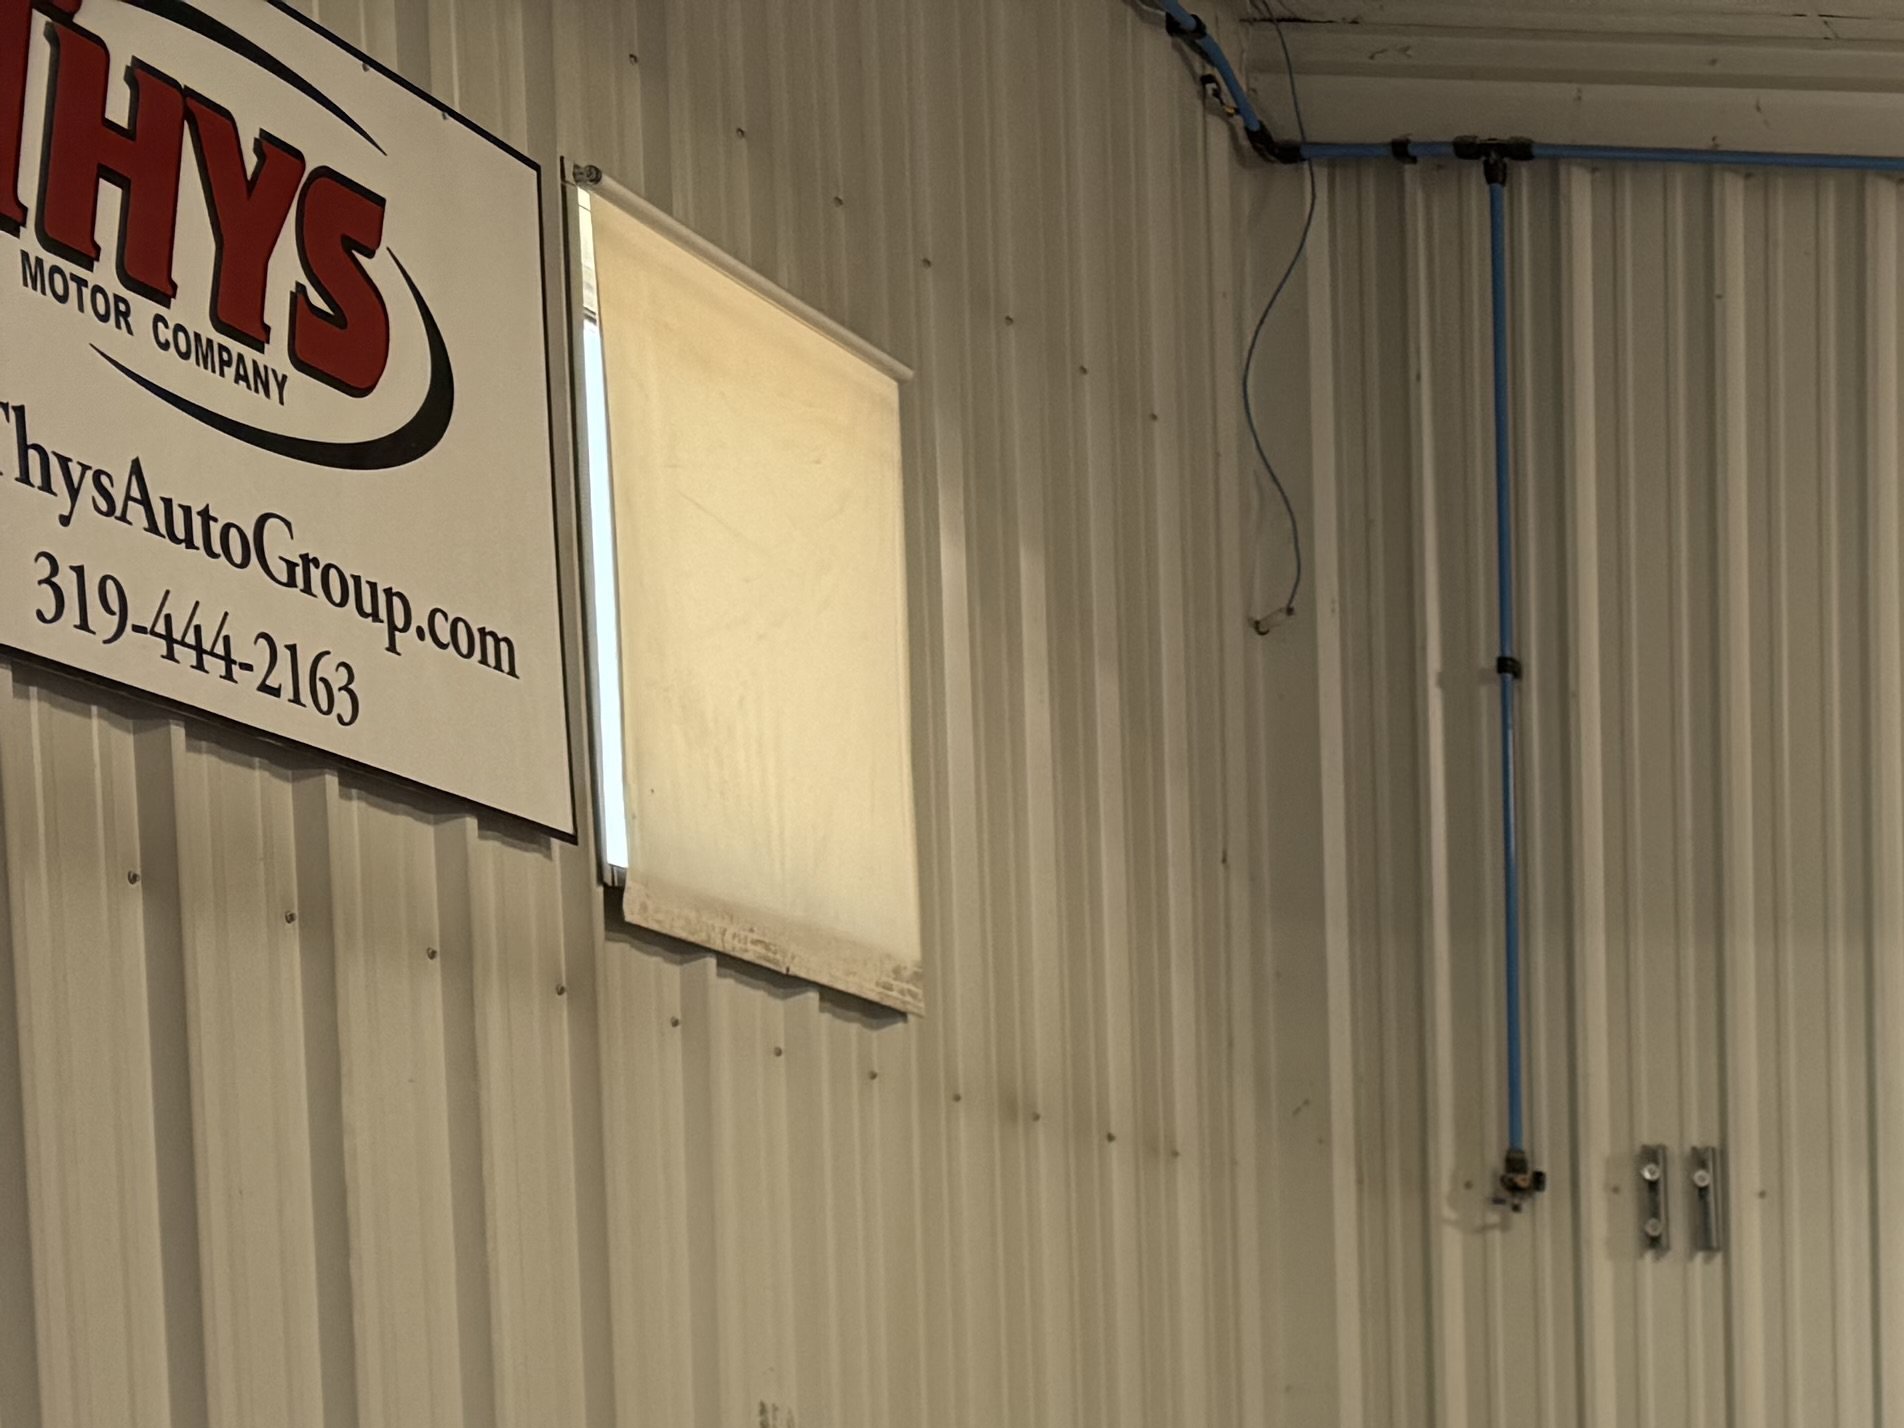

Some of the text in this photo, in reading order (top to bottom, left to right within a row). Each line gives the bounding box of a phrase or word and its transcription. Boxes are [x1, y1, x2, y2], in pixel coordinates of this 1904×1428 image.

[20, 249, 288, 406] MOTOR COMPANY
[0, 401, 520, 680] hysAutoGroup.com
[34, 551, 360, 727] 319-444-2163
